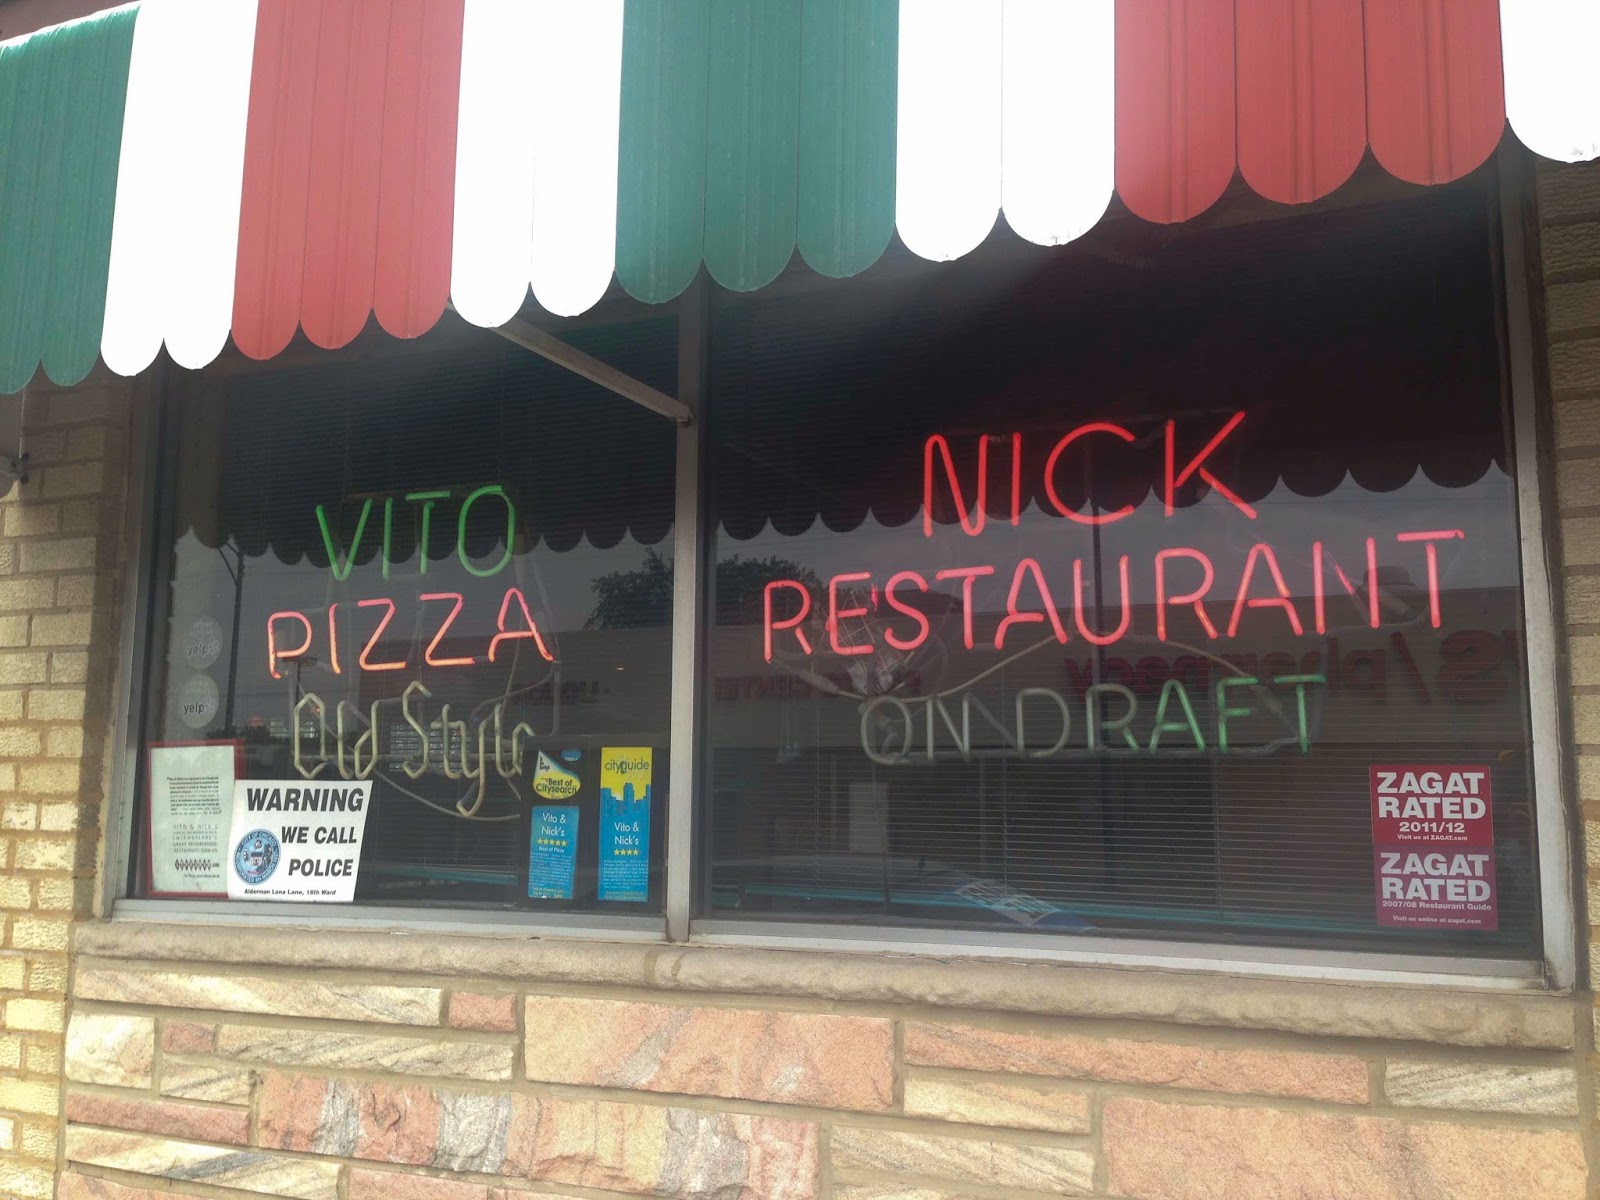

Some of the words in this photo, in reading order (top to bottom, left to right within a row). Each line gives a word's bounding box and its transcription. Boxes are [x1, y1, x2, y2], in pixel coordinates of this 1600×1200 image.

[924, 411, 1257, 537] NICK
[316, 485, 515, 581] VITO
[763, 529, 1465, 663] RESTAURANT
[267, 588, 553, 679] PIZZA
[187, 643, 208, 657] yelp
[184, 701, 205, 715] yelp
[294, 692, 381, 780] Old
[604, 757, 649, 774] cityguide
[536, 783, 577, 794] Citysearch
[548, 778, 563, 786] Best
[1377, 772, 1485, 794] ZAGAT
[246, 787, 364, 813] WARNING
[1378, 796, 1486, 820] RATED
[542, 812, 557, 823] Vito
[559, 814, 567, 824] &
[614, 822, 630, 832] Vito
[633, 822, 640, 832] &
[1399, 821, 1465, 833] 2011/12
[281, 826, 308, 844] WE
[314, 826, 357, 844] CALL
[541, 826, 565, 837] Nick's
[614, 834, 639, 845] Nick's
[288, 859, 353, 877] POLICE
[1380, 852, 1489, 877] ZAGAT
[1381, 877, 1491, 902] RATED
[1382, 900, 1417, 908] 2007/08
[1419, 901, 1465, 910] Restaurant
[1467, 903, 1492, 911] Guide
